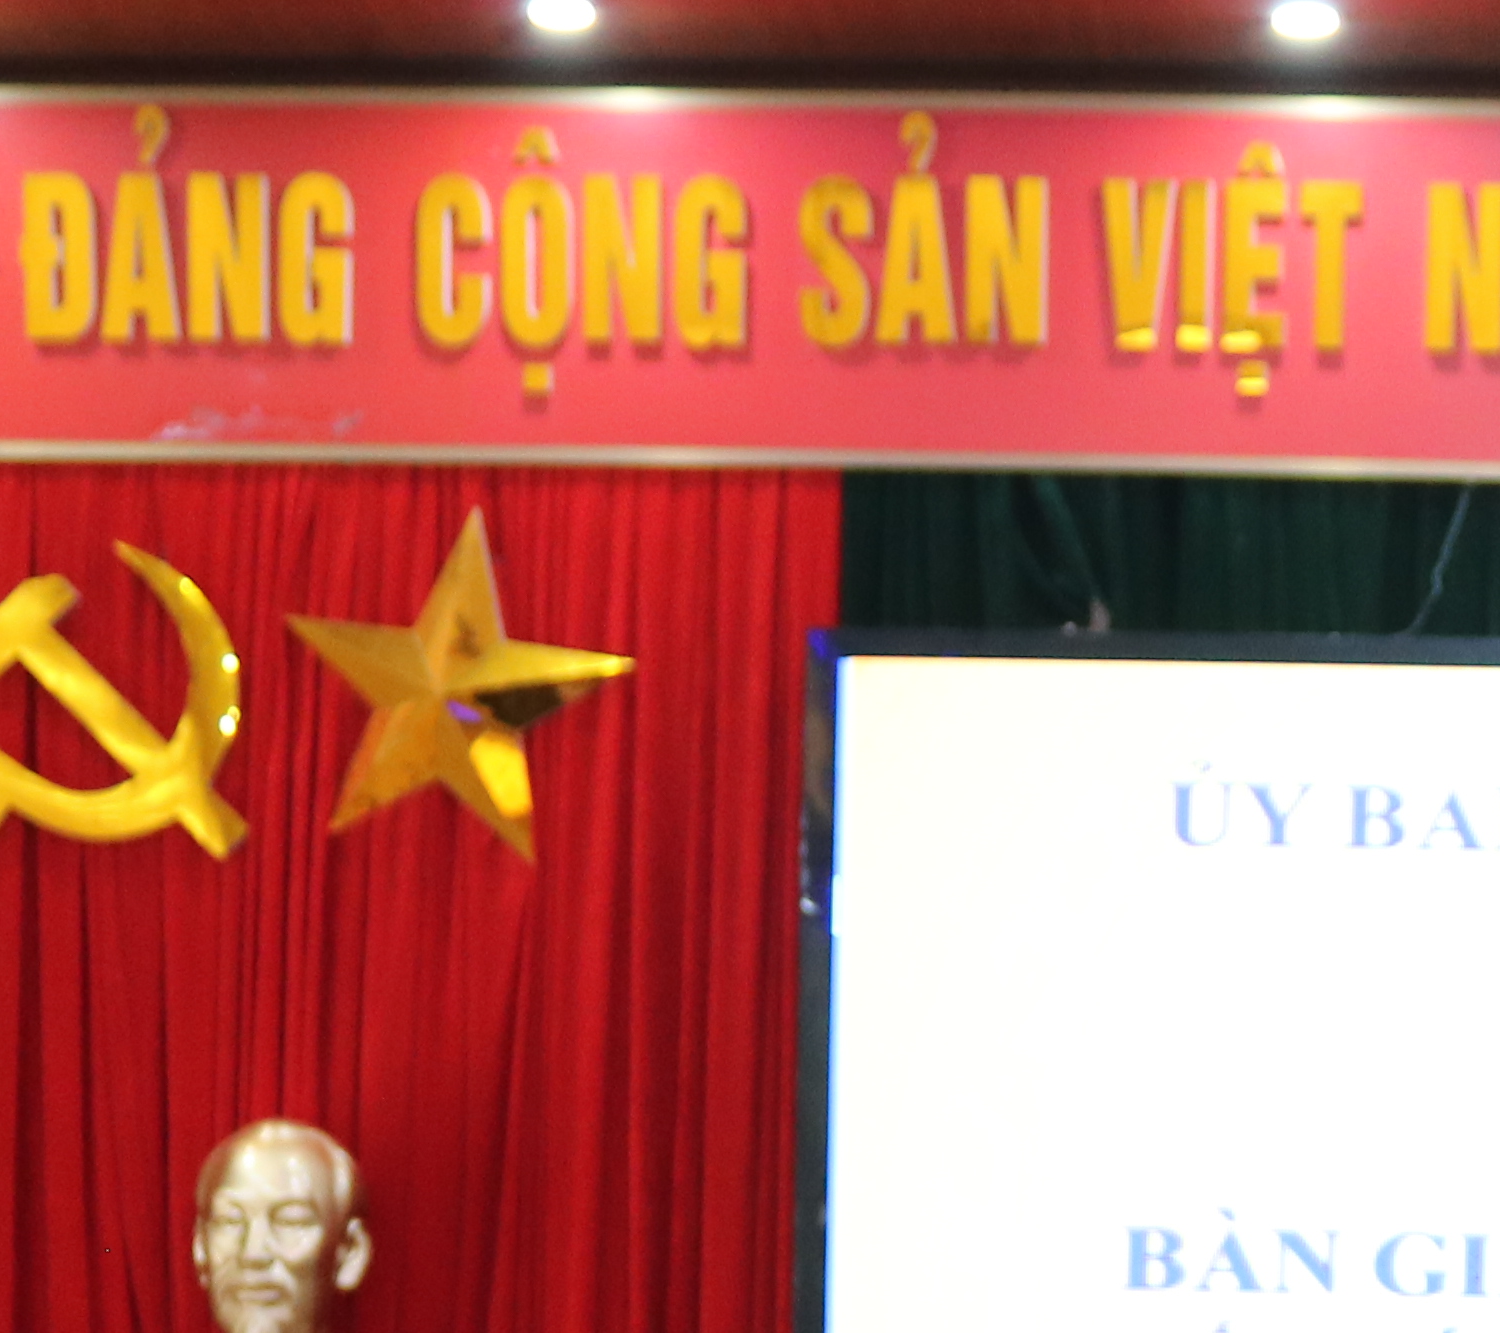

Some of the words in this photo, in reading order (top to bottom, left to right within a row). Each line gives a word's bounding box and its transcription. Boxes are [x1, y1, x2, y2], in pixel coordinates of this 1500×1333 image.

[22, 105, 353, 345] ĐẢNG
[417, 128, 747, 394] CỘNG
[800, 112, 1047, 347] SẢN
[1103, 144, 1361, 395] VIỆT
[1123, 1207, 1339, 1294] BÀN
